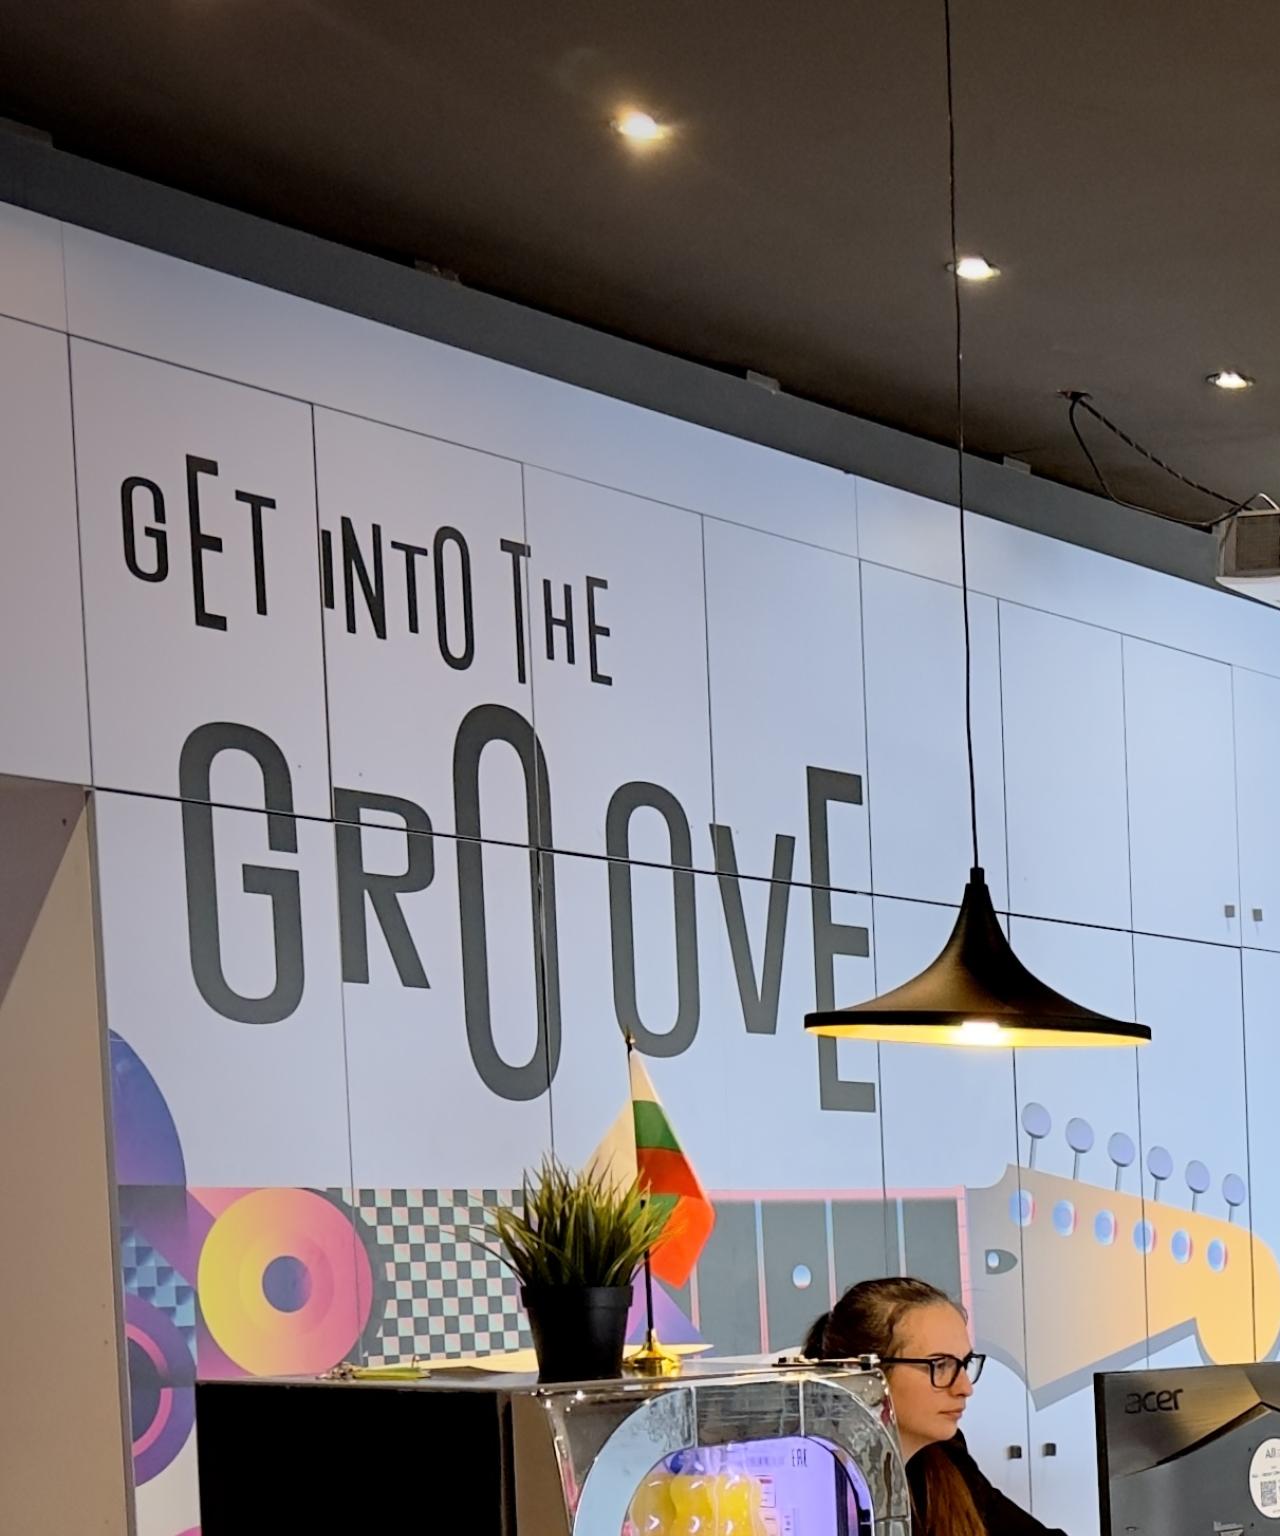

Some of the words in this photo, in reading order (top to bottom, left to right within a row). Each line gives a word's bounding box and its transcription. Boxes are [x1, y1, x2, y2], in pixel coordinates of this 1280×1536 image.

[120, 454, 277, 632] GET
[320, 515, 475, 671] INTO
[500, 538, 614, 686] THE
[178, 703, 877, 1113] GROOVE
[1124, 1388, 1184, 1415] acer
